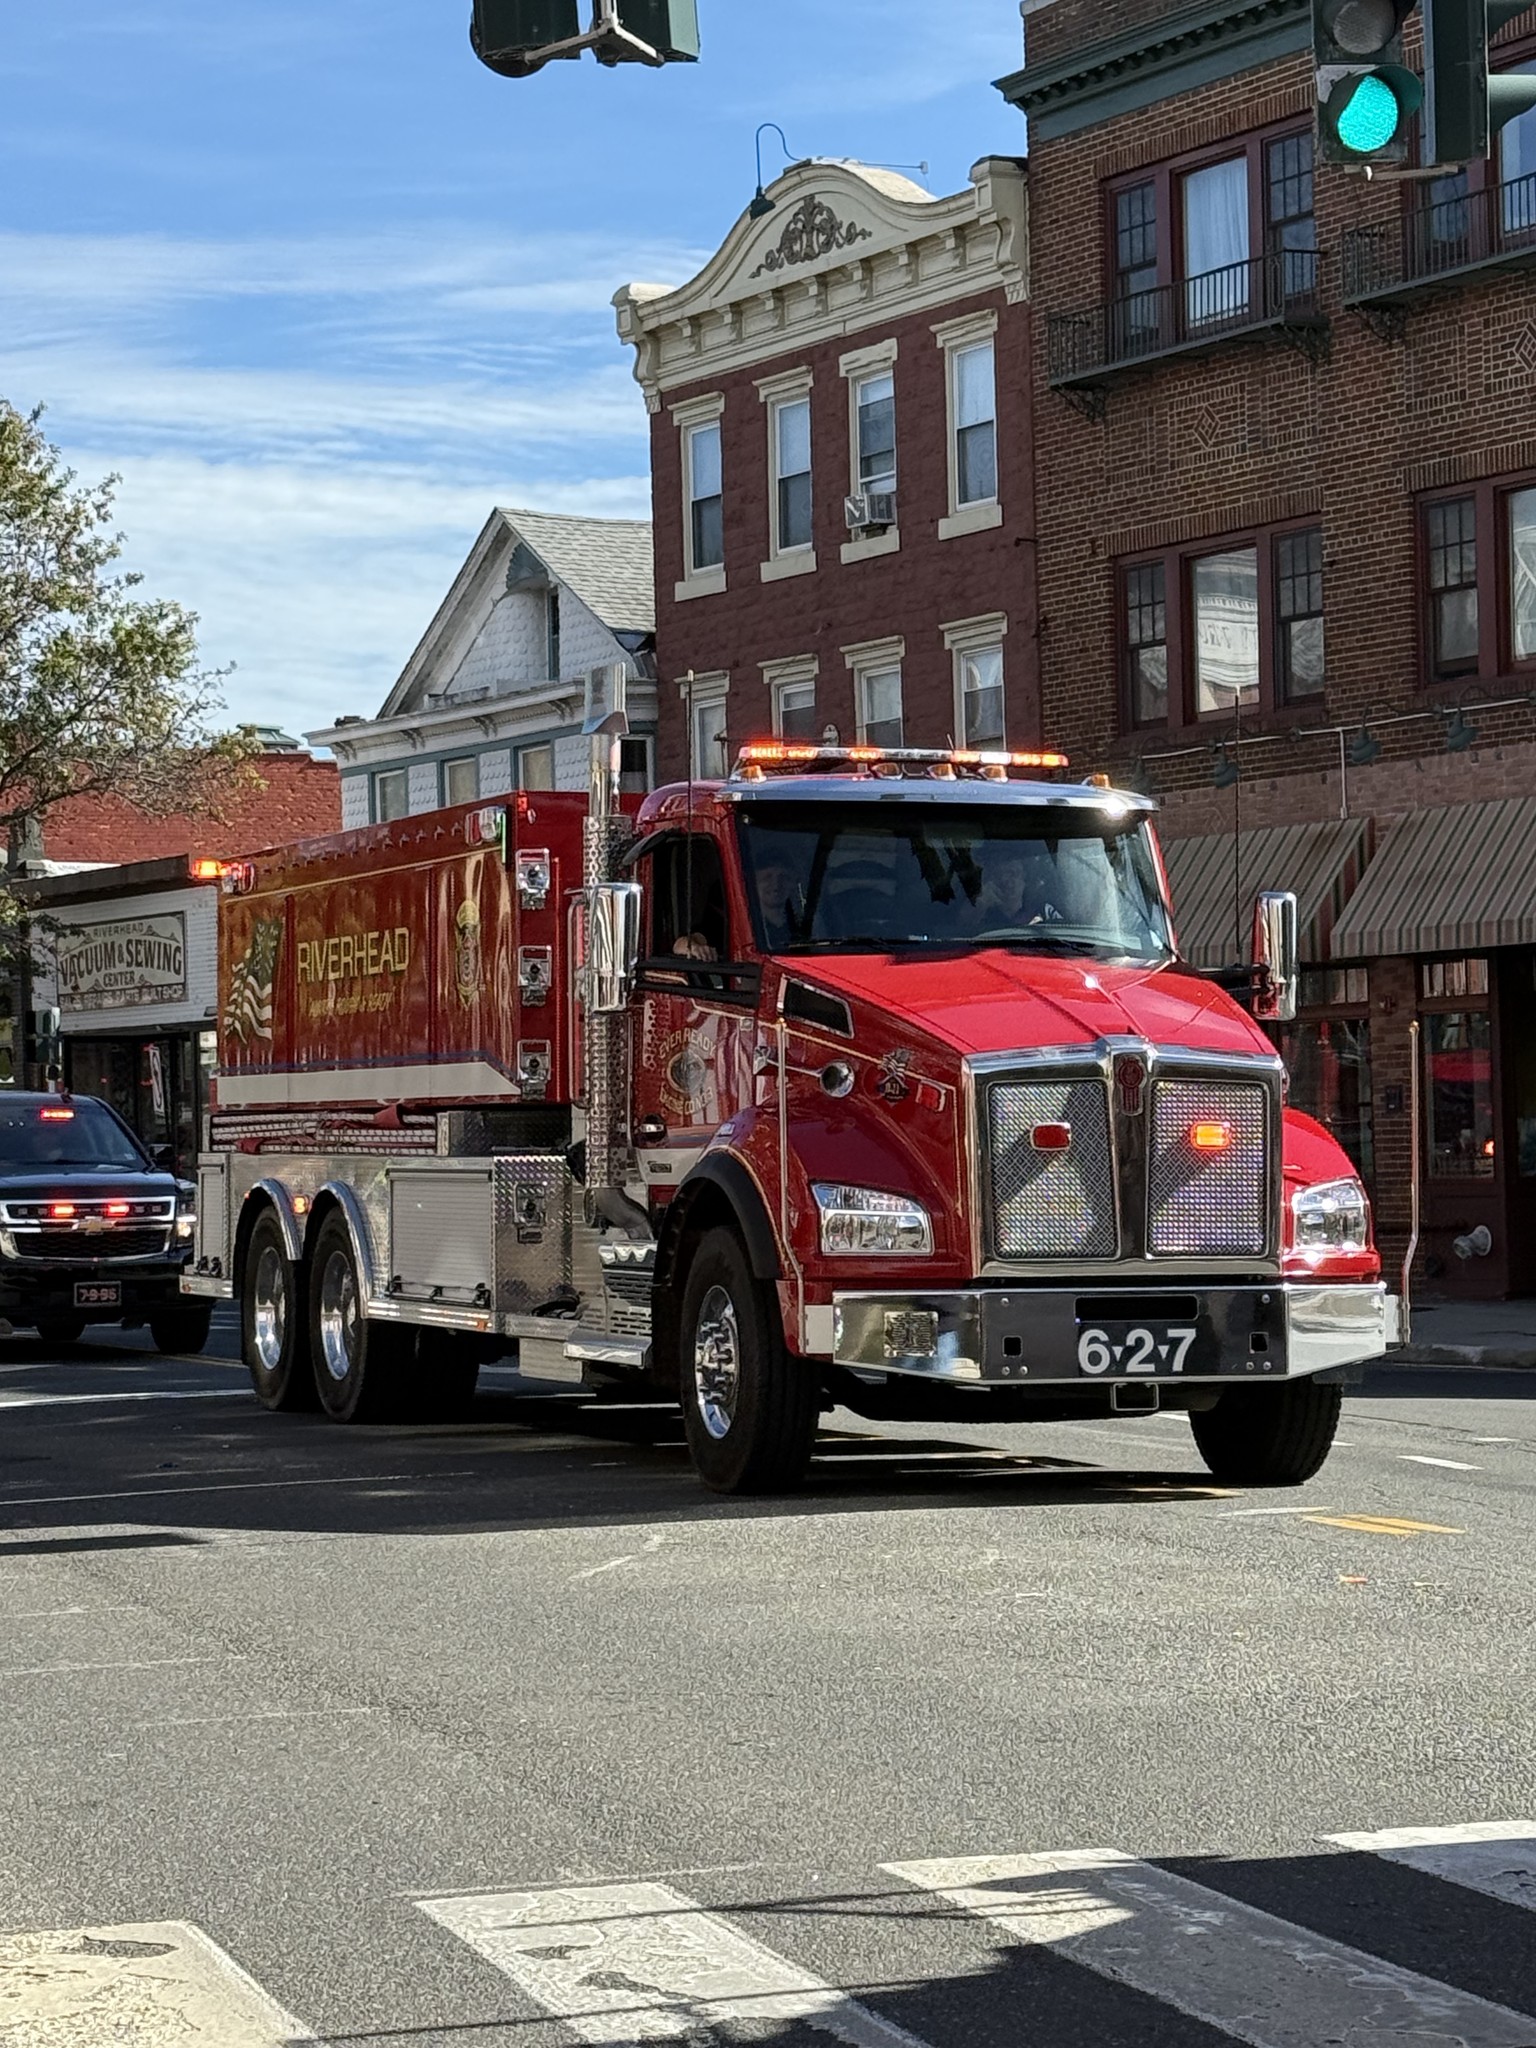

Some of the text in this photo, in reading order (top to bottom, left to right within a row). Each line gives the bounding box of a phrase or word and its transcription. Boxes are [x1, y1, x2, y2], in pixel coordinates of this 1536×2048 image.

[94, 922, 144, 937] RIVERHEAD
[60, 939, 182, 987] VACUUM & SEWING
[298, 928, 410, 981] RIVERHEAD
[103, 971, 135, 988] CENTER
[659, 1027, 717, 1059] EVER READY
